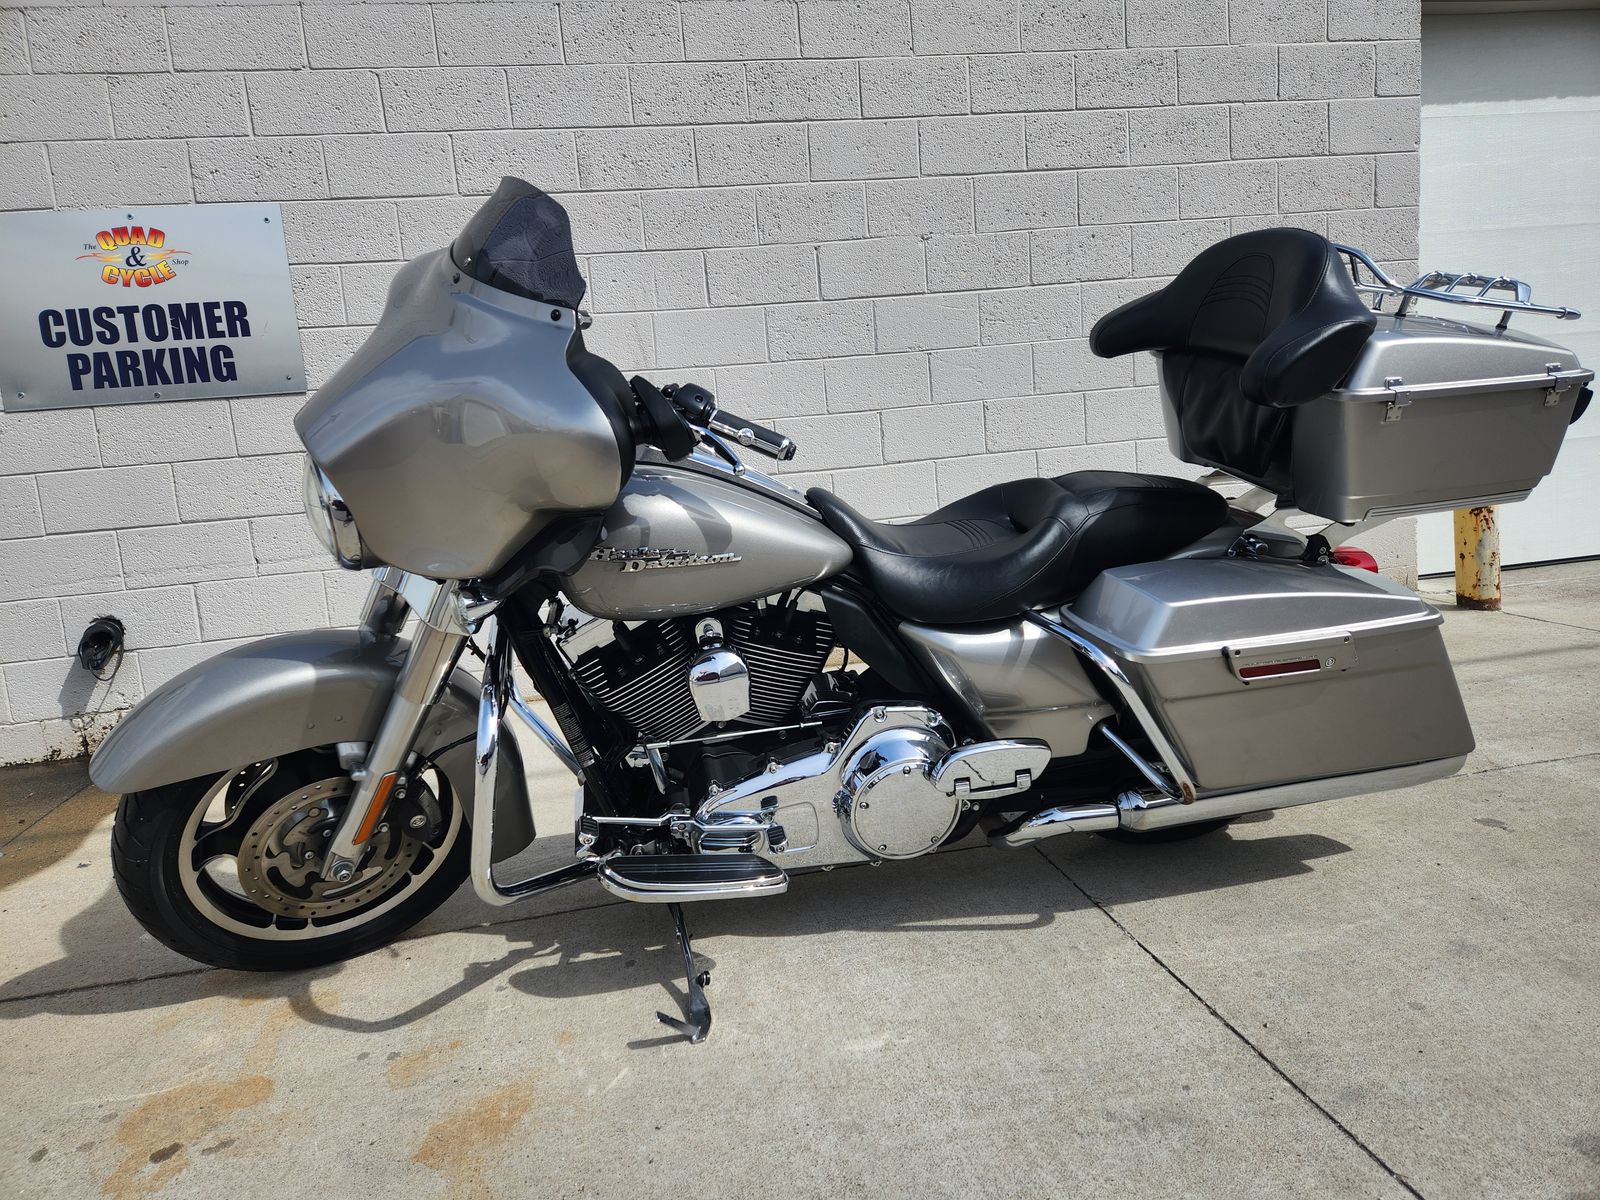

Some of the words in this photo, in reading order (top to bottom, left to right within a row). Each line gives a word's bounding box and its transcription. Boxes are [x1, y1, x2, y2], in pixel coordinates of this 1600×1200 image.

[95, 226, 165, 251] QUAD
[125, 246, 147, 267] &
[172, 258, 189, 266] Shop
[101, 260, 177, 288] CYCLE
[38, 300, 251, 348] CUSTOMER
[66, 344, 238, 391] PARKING
